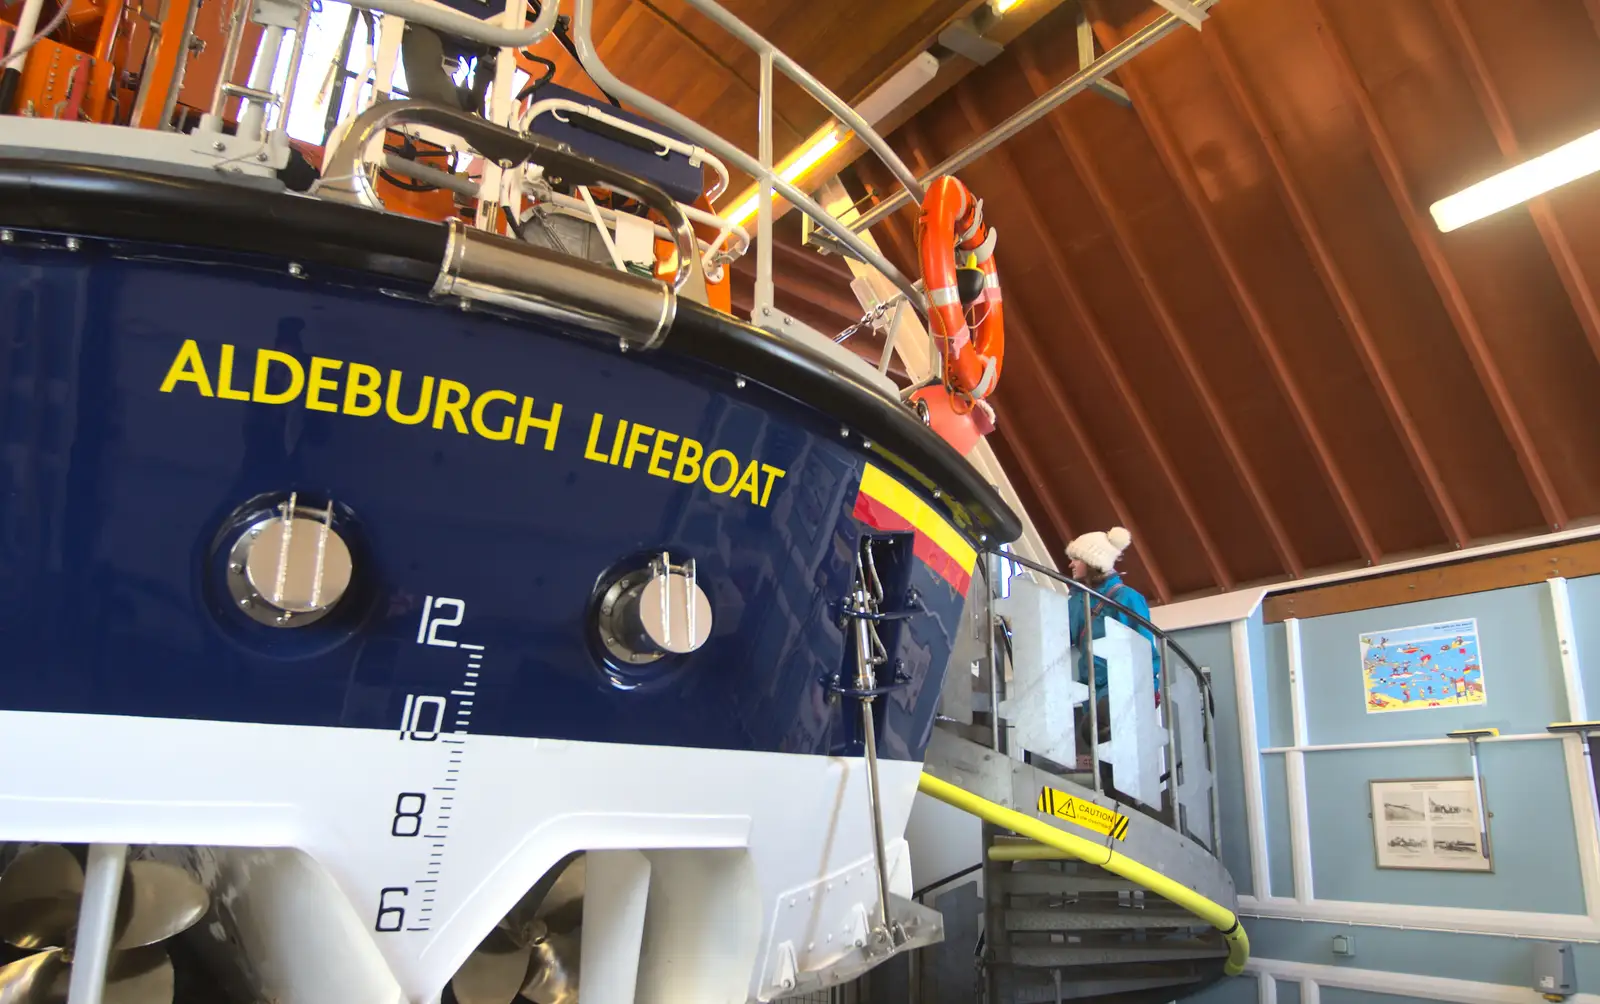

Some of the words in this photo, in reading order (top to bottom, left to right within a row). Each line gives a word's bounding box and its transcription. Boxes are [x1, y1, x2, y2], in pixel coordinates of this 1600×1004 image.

[159, 339, 563, 451] ALDEBURGH
[584, 412, 786, 508] LIFEBOAT
[416, 595, 466, 648] 12
[400, 694, 447, 741] 10
[391, 792, 426, 837] 8
[1078, 804, 1114, 823] CAUTION
[375, 887, 409, 932] 6
